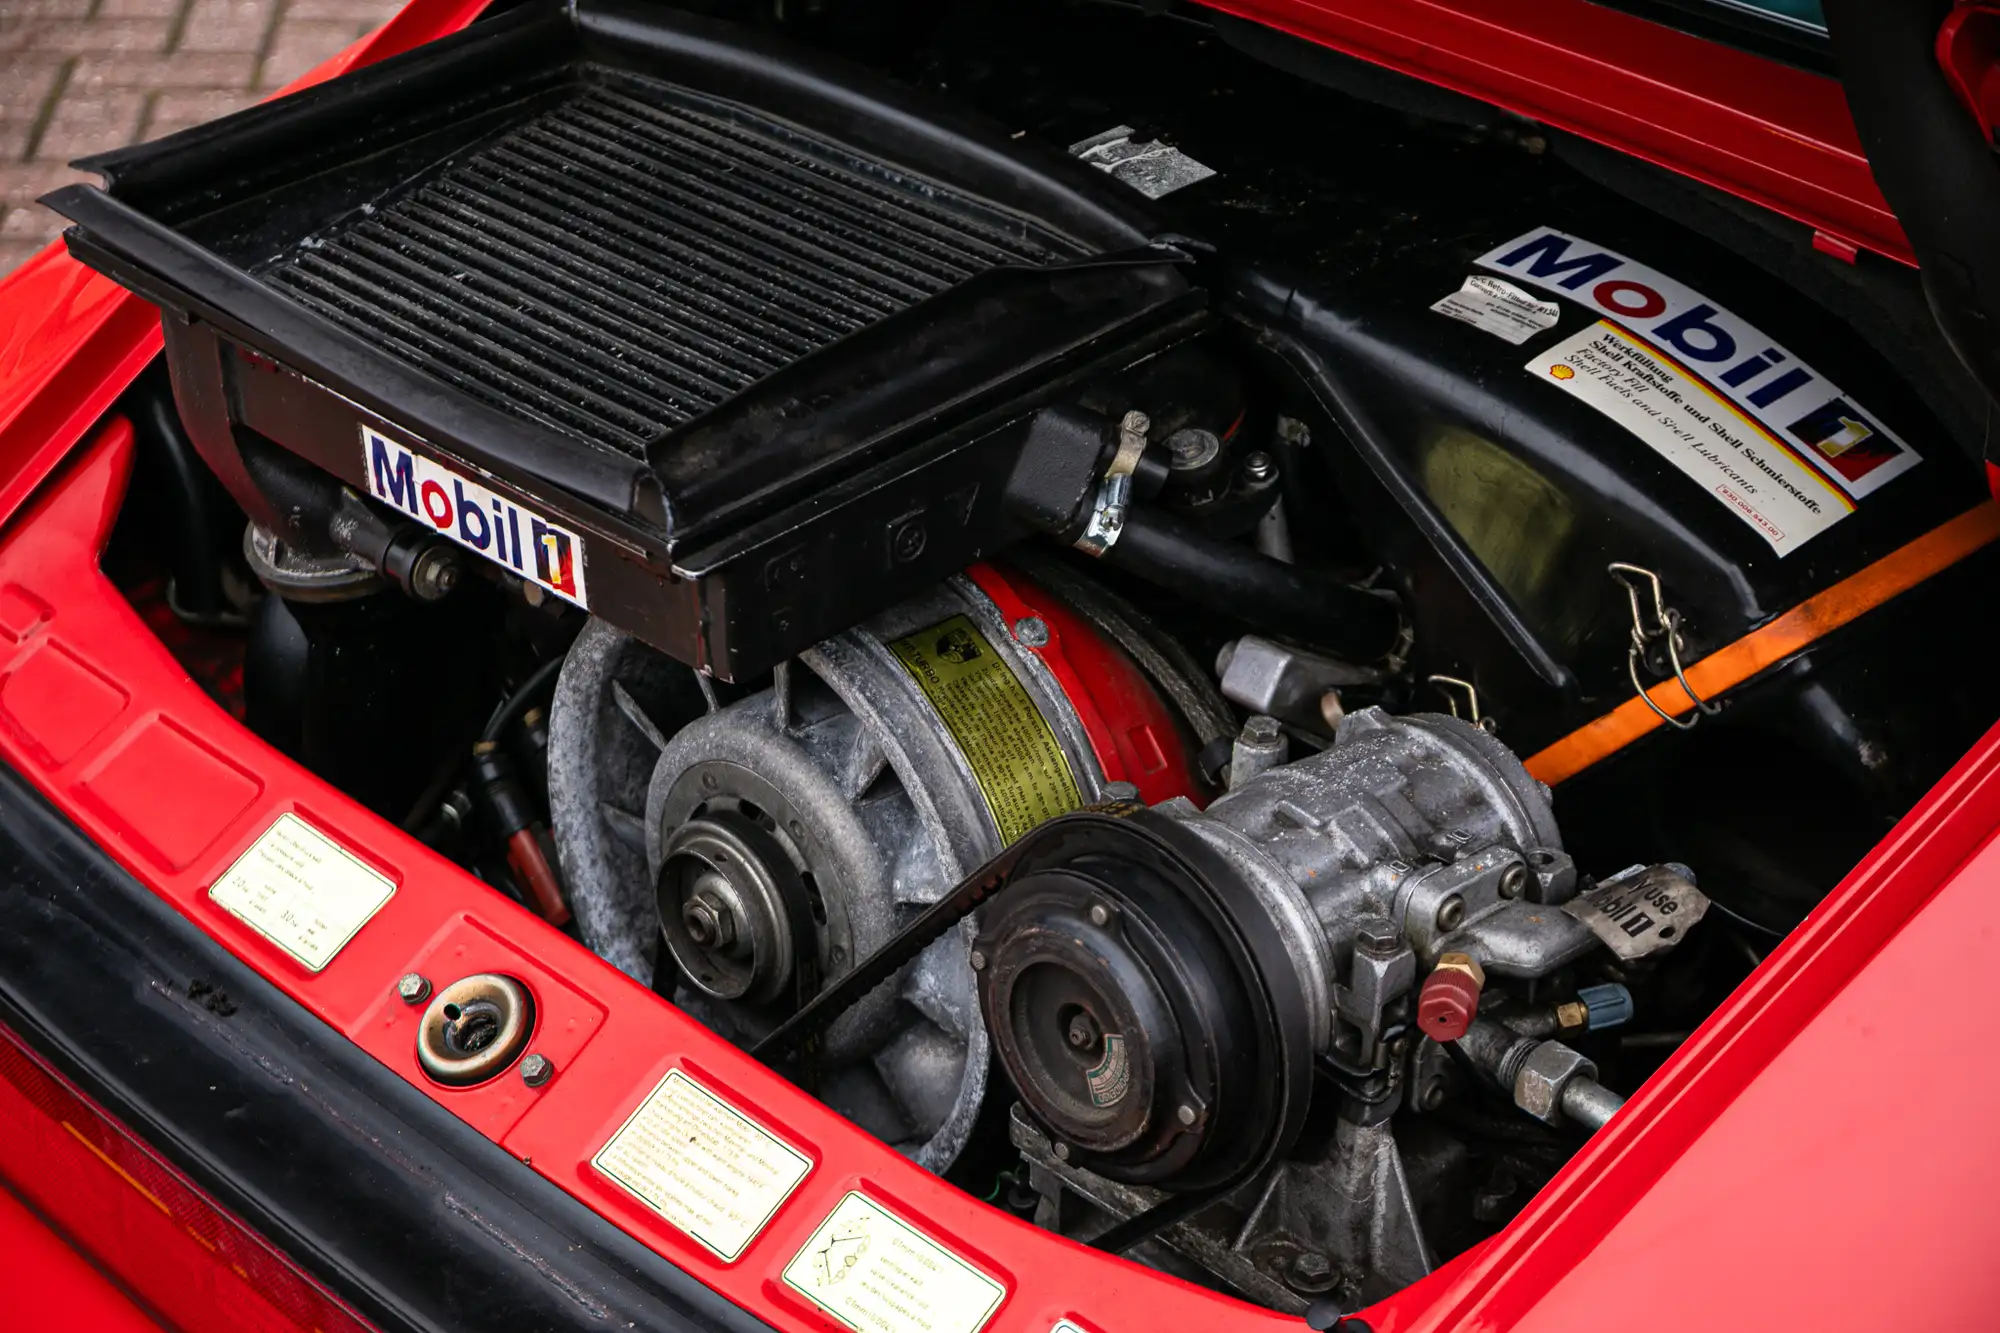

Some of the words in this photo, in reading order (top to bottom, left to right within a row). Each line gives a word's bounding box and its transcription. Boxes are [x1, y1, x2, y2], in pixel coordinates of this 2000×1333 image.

[1494, 233, 1813, 408] Mobil
[1816, 414, 1873, 458] 1
[1601, 333, 1674, 383] Werkfüllung
[1576, 347, 1625, 377] Factory
[1624, 376, 1650, 393] Fill
[1564, 354, 1601, 376] Shell
[1598, 374, 1634, 399] Fuels
[1632, 398, 1662, 418] and
[1658, 413, 1695, 442] Shell
[1691, 441, 1759, 495] Lubricants
[1588, 340, 1624, 362] Shell
[1622, 359, 1684, 404] Kraftstoffe
[1683, 403, 1710, 424] und
[1708, 421, 1743, 449] Shell
[1740, 447, 1822, 515] Schmierstoffe
[370, 435, 524, 571] Mobil
[541, 533, 562, 585] 1
[913, 651, 939, 684] TURBO
[1023, 705, 1044, 739] Porsche
[957, 715, 973, 734] punto
[999, 787, 1011, 807] 4000
[1004, 764, 1018, 784] avant
[987, 779, 1007, 823] temperatura
[1627, 915, 1645, 932] 1
[1644, 886, 1679, 915] use
